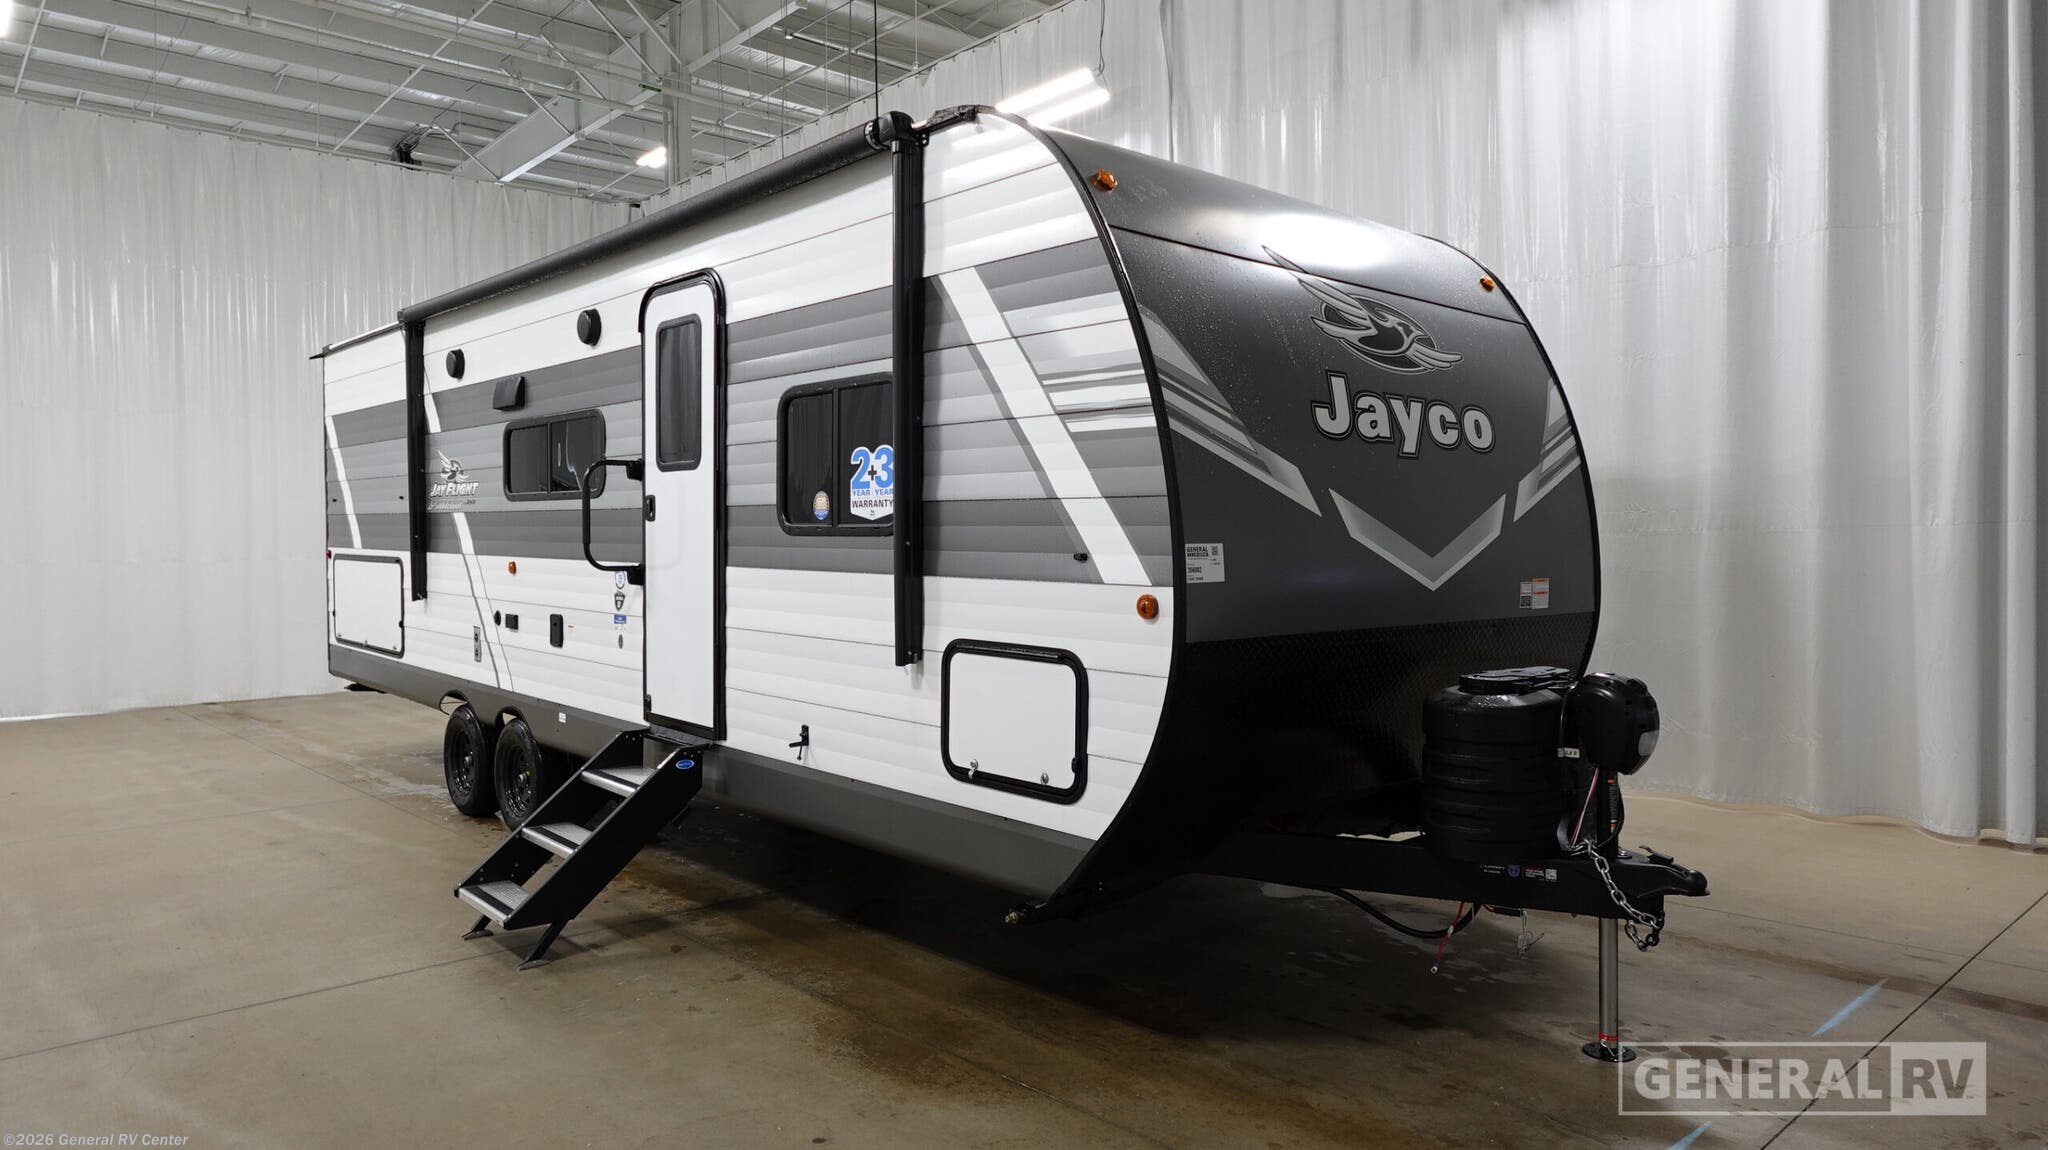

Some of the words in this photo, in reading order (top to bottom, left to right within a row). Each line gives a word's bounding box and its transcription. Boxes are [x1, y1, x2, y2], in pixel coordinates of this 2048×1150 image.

[1311, 371, 1496, 458] Jayco
[430, 483, 449, 498] JAY
[445, 482, 479, 497] FLIGHT
[853, 489, 870, 497] YEAR
[852, 499, 894, 508] WARRANTY
